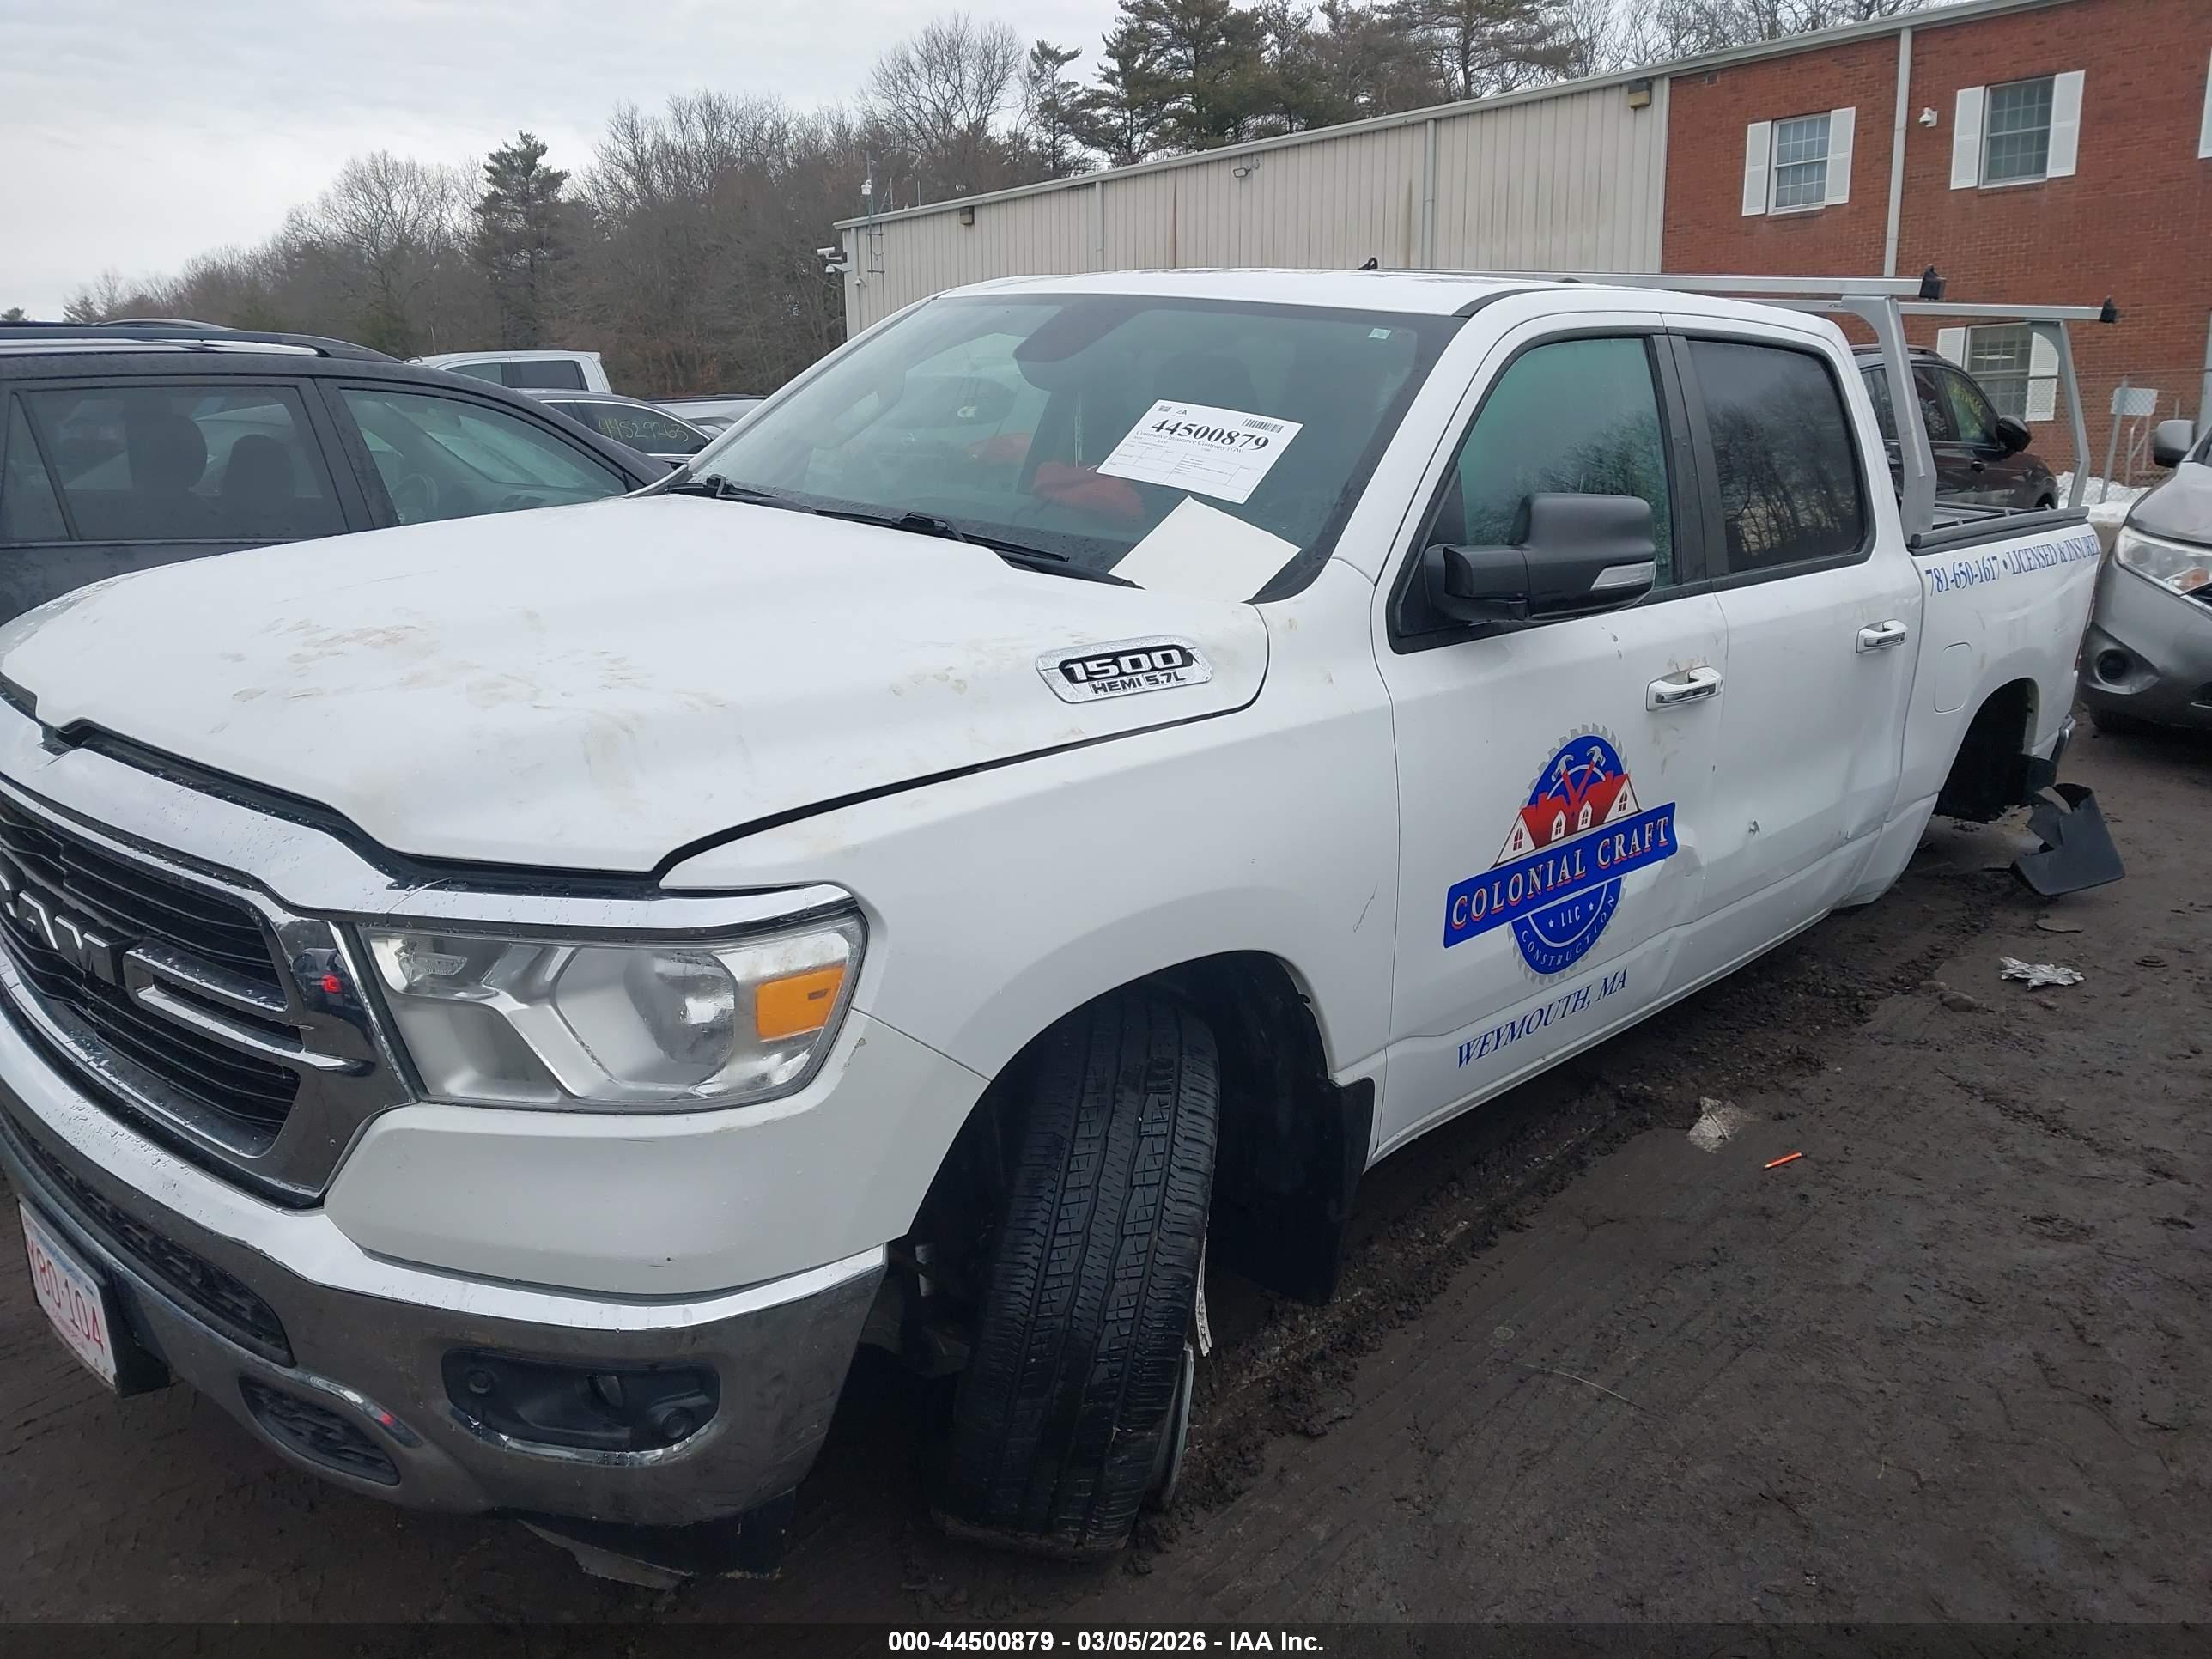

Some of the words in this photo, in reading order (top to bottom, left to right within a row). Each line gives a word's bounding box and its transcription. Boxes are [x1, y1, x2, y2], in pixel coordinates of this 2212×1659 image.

[598, 418, 689, 443] 44529263
[1151, 418, 1270, 451] 44500879
[1925, 556, 2001, 597] 781-650-1617
[2006, 543, 2058, 575] LICENSED
[2057, 543, 2068, 563] &
[1064, 648, 1183, 682] 1500
[1091, 677, 1143, 695] HEMI
[1145, 672, 1187, 686] 5.7L
[1451, 848, 1586, 928] COLONIAL
[1596, 817, 1669, 870] CRAFT
[1521, 894, 1615, 967] CONSTRUCTION
[1560, 904, 1581, 927] LLC
[1456, 989, 1591, 1070] WEYMOUTH,
[1595, 966, 1628, 1006] MA
